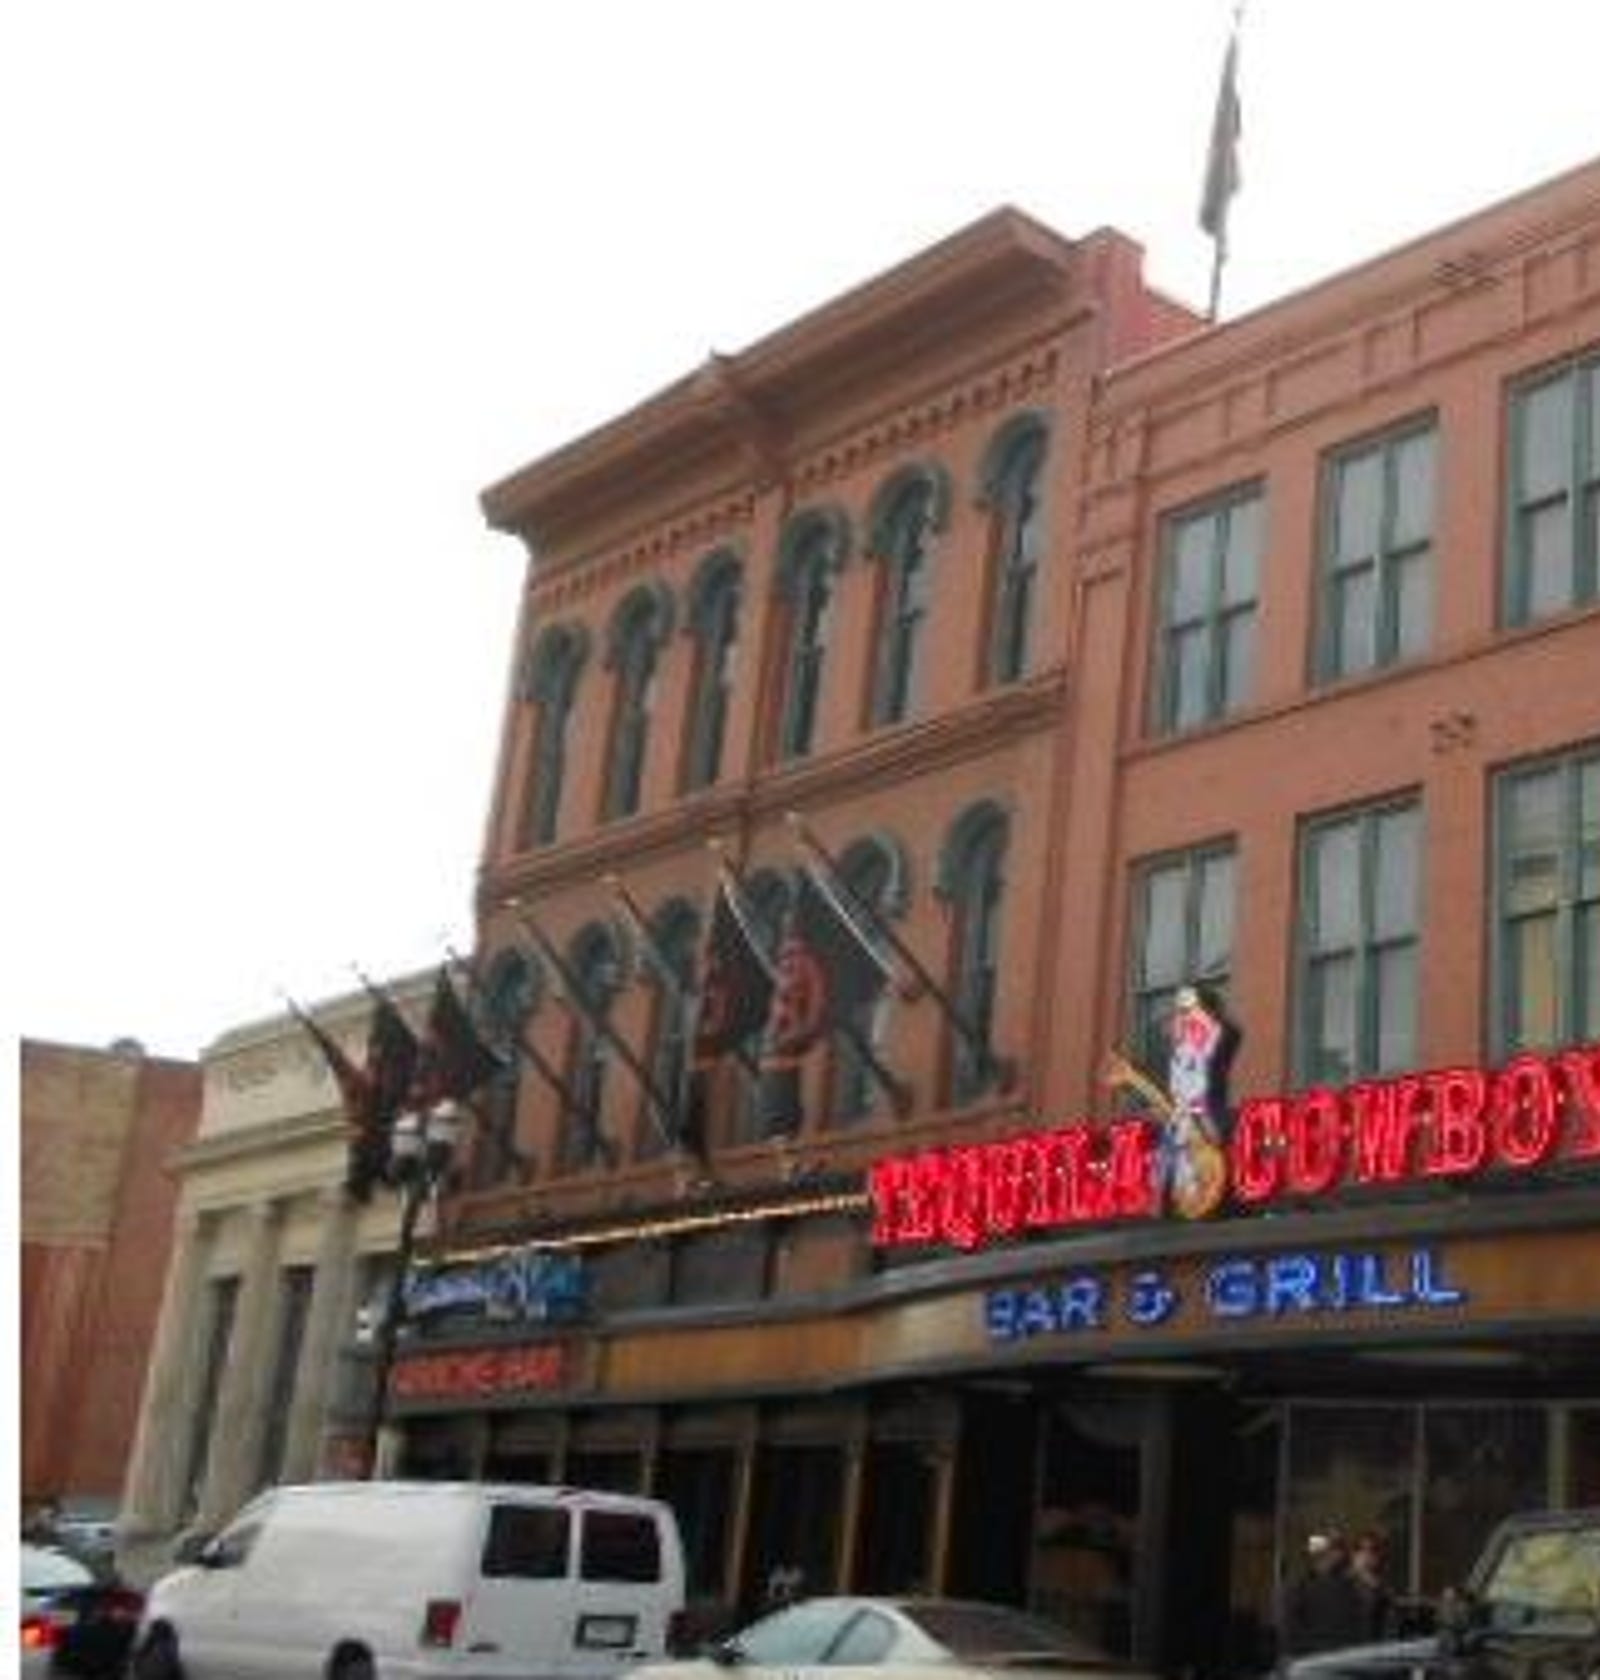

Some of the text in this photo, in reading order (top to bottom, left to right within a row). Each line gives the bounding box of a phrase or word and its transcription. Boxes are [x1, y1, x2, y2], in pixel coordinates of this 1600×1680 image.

[871, 1119, 1160, 1249] TEQUILA
[986, 1252, 1463, 1337] BAR & GRILL
